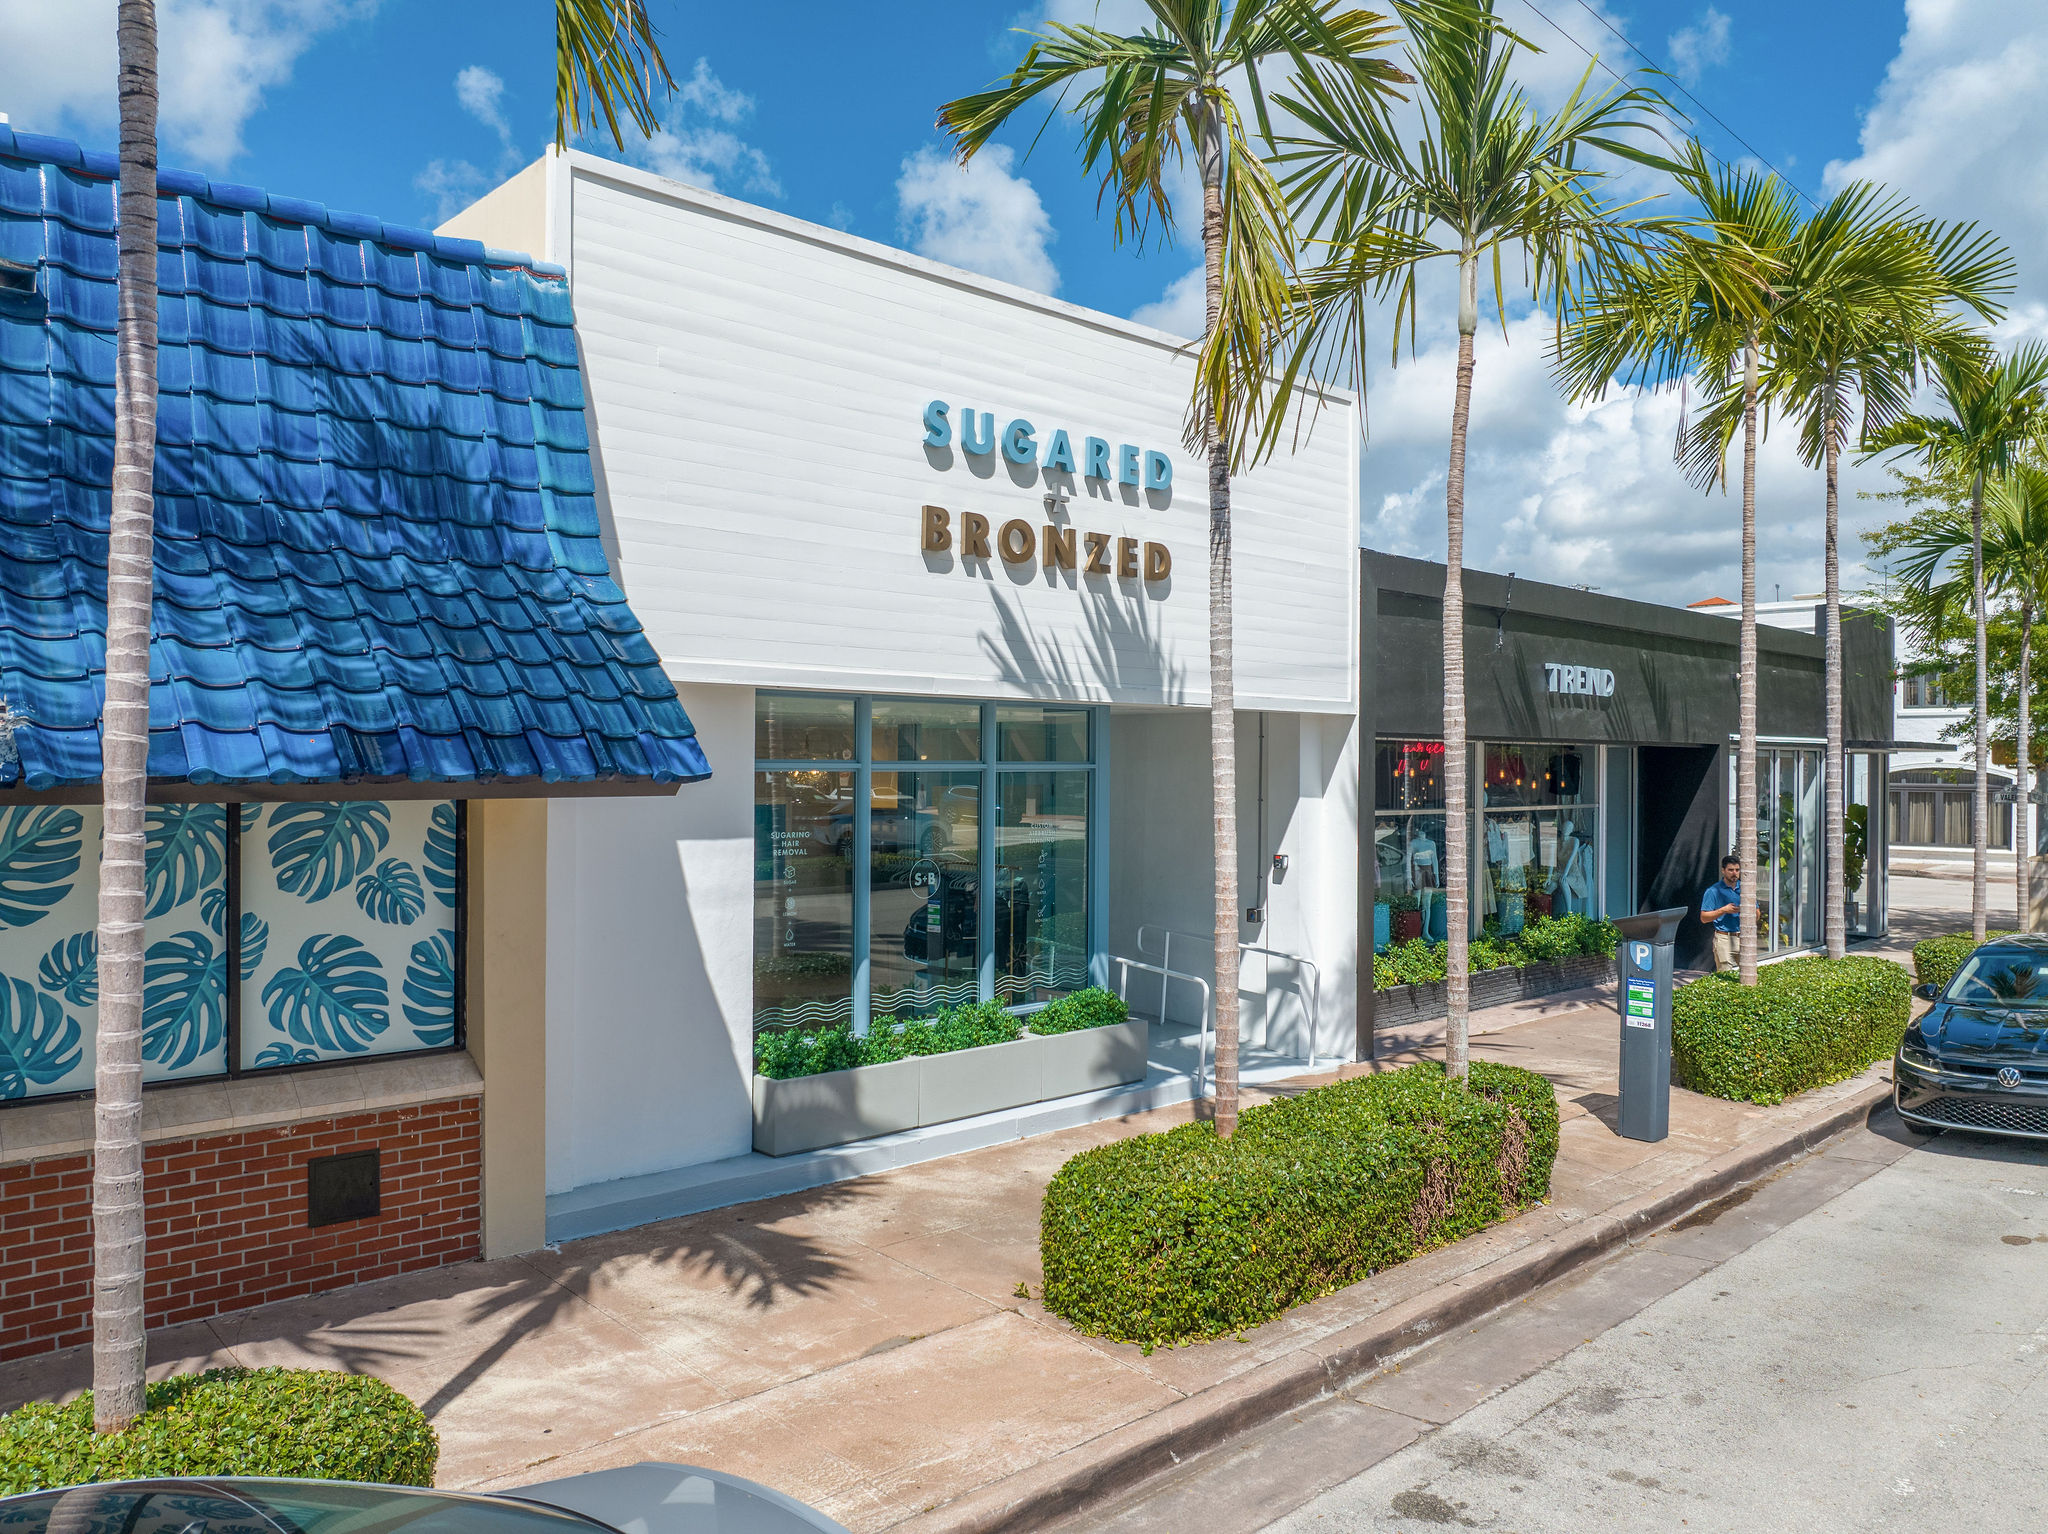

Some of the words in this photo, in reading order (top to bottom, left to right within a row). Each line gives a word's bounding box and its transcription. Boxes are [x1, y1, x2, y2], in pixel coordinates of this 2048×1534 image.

[922, 399, 1173, 491] SUGARED
[920, 504, 1172, 581] BRONZED
[1544, 662, 1615, 698] TREND
[770, 831, 811, 839] SUGARING
[773, 848, 808, 857] REMOVAL
[781, 840, 800, 848] HAIR
[914, 872, 936, 886] S+B
[1636, 944, 1650, 965] P
